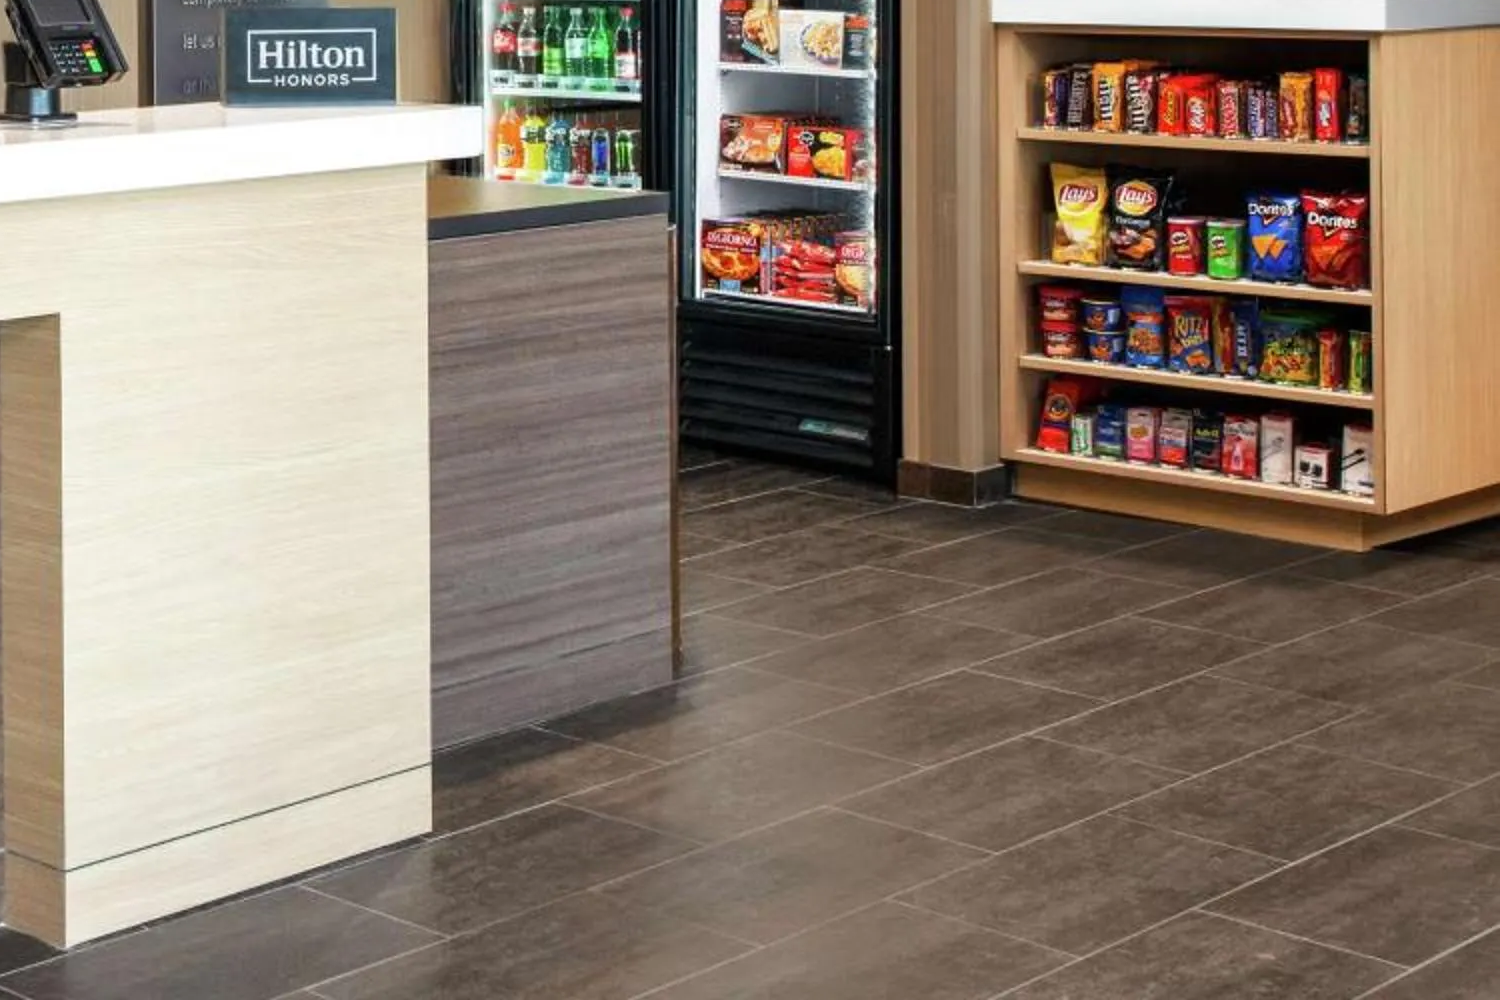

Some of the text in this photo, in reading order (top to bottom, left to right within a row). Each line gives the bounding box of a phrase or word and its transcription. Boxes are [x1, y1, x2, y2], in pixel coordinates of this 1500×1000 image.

[258, 39, 365, 70] Hilton
[274, 73, 351, 87] HONORS
[1248, 203, 1295, 216] Doritos
[1307, 211, 1357, 229] Doritos
